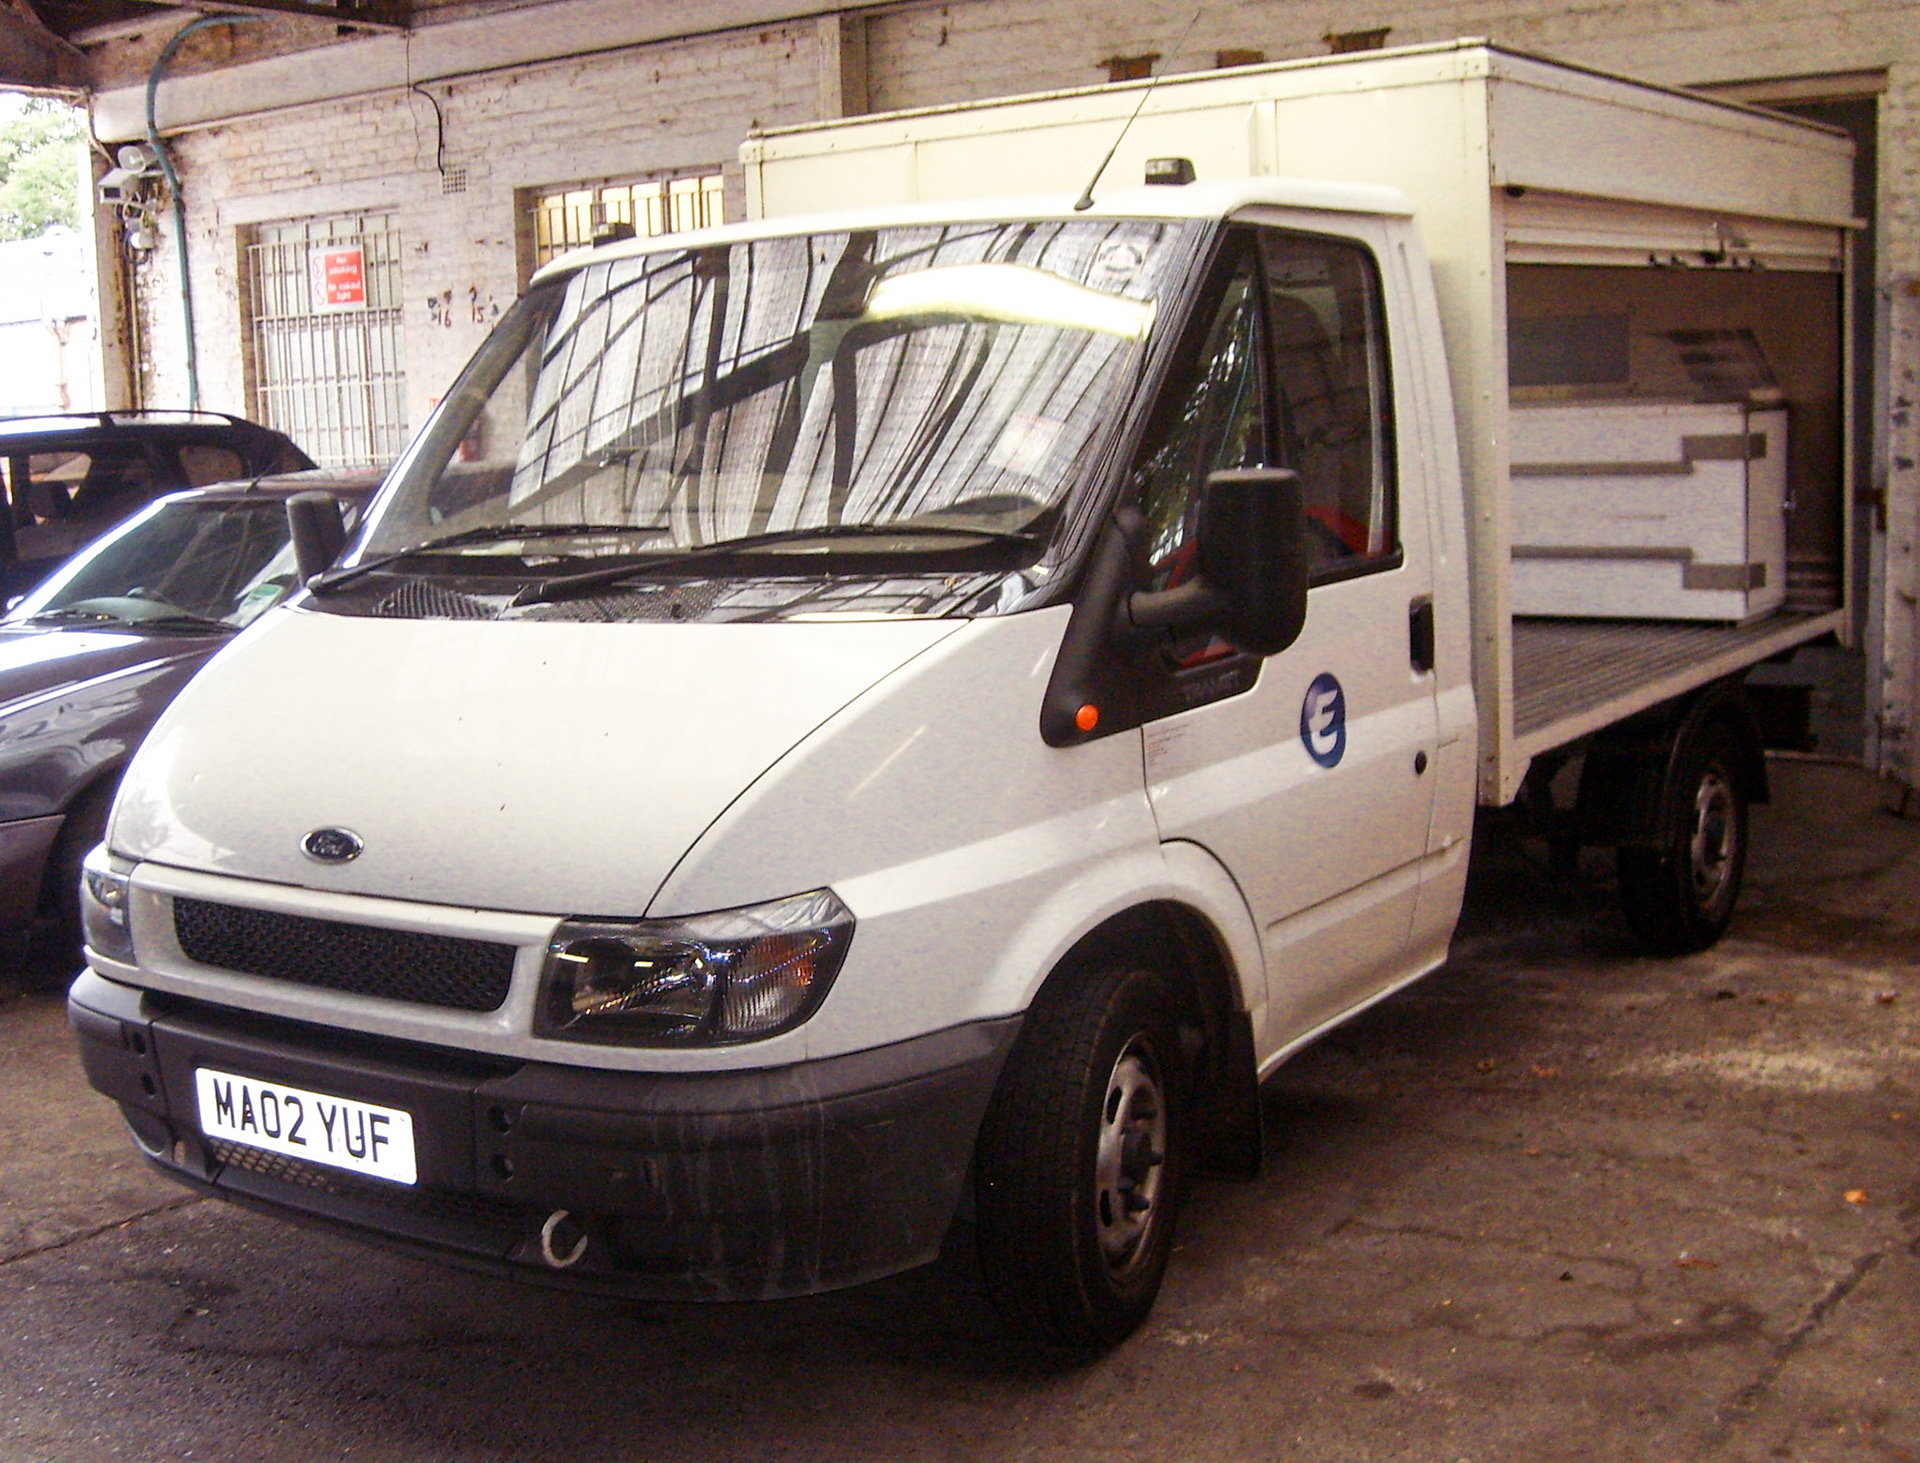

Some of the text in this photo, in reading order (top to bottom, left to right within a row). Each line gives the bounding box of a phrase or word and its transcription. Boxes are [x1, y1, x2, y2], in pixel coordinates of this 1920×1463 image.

[328, 265, 358, 275] smoking
[437, 305, 485, 327] 16 15
[213, 1078, 390, 1163] MA02 YUF
